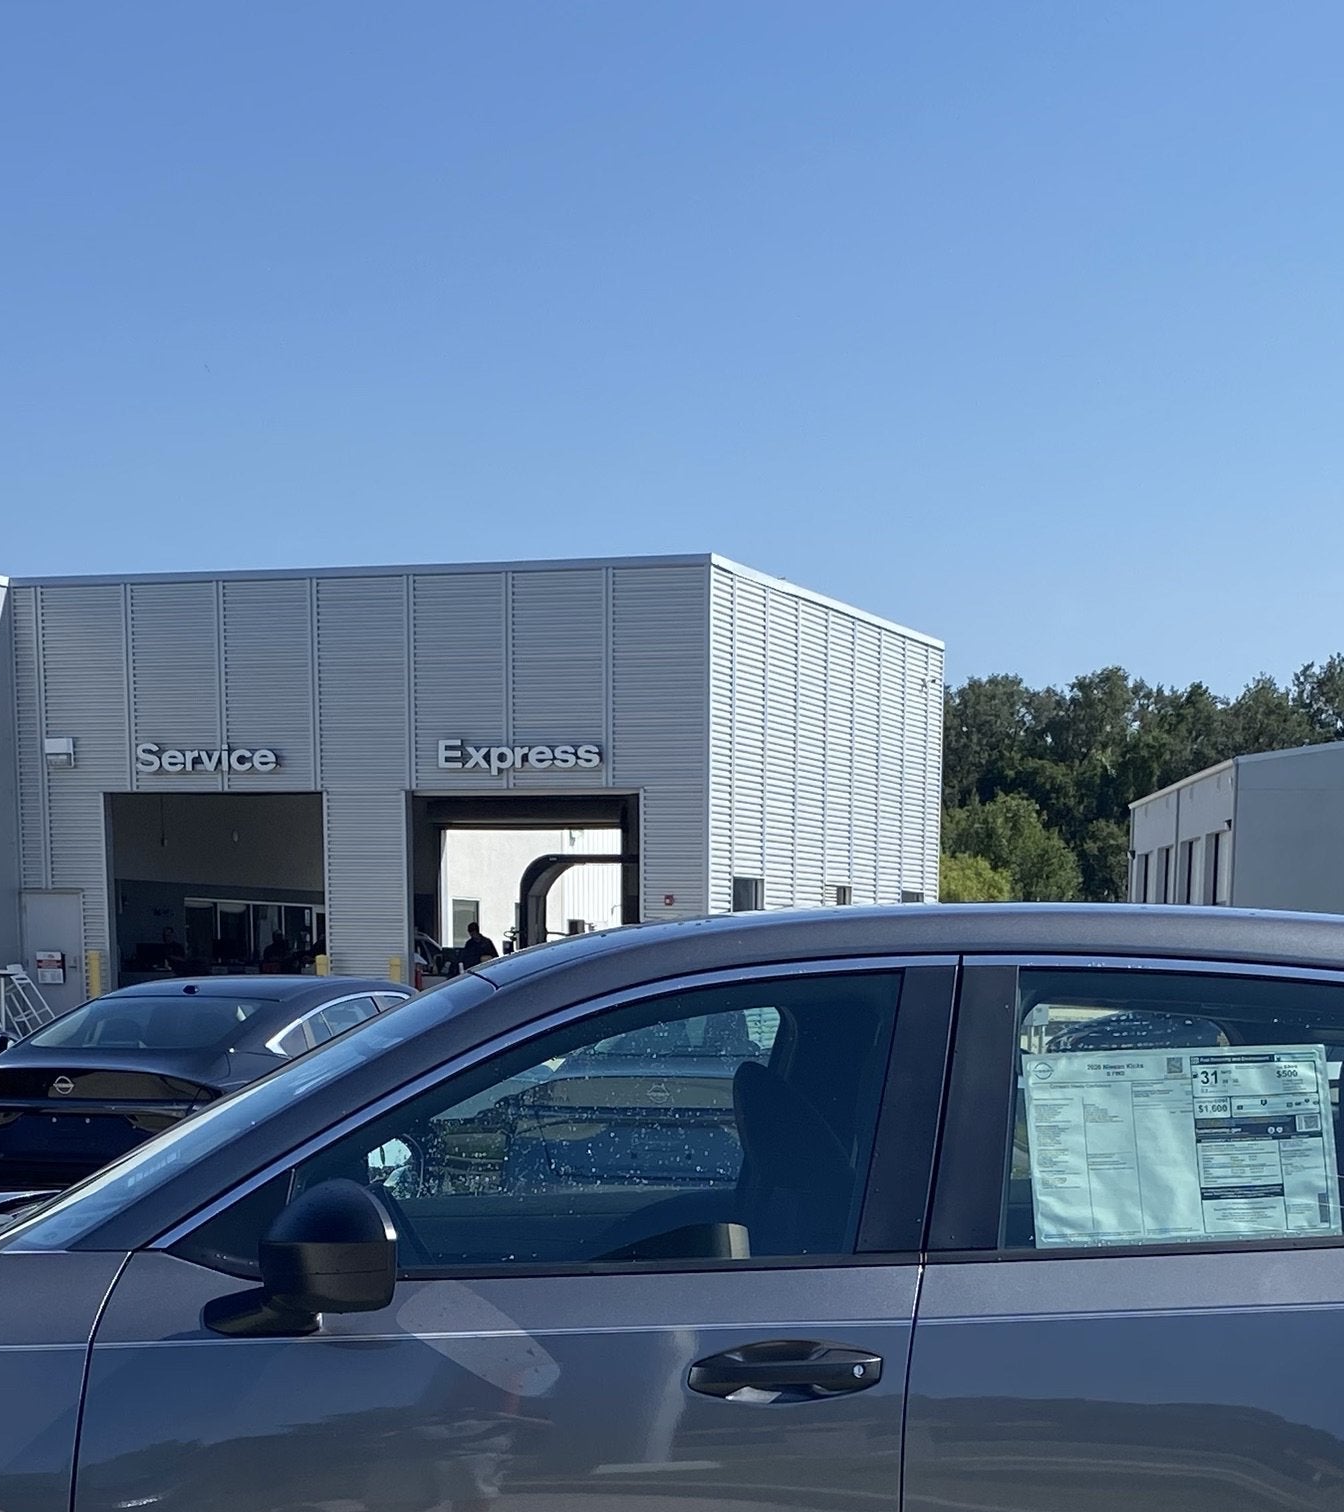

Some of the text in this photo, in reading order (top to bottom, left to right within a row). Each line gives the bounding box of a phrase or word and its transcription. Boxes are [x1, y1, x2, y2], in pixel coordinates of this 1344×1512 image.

[136, 742, 277, 773] Service
[437, 739, 601, 776] Express
[1200, 1070, 1218, 1085] 31
[1276, 1069, 1298, 1079] $500
